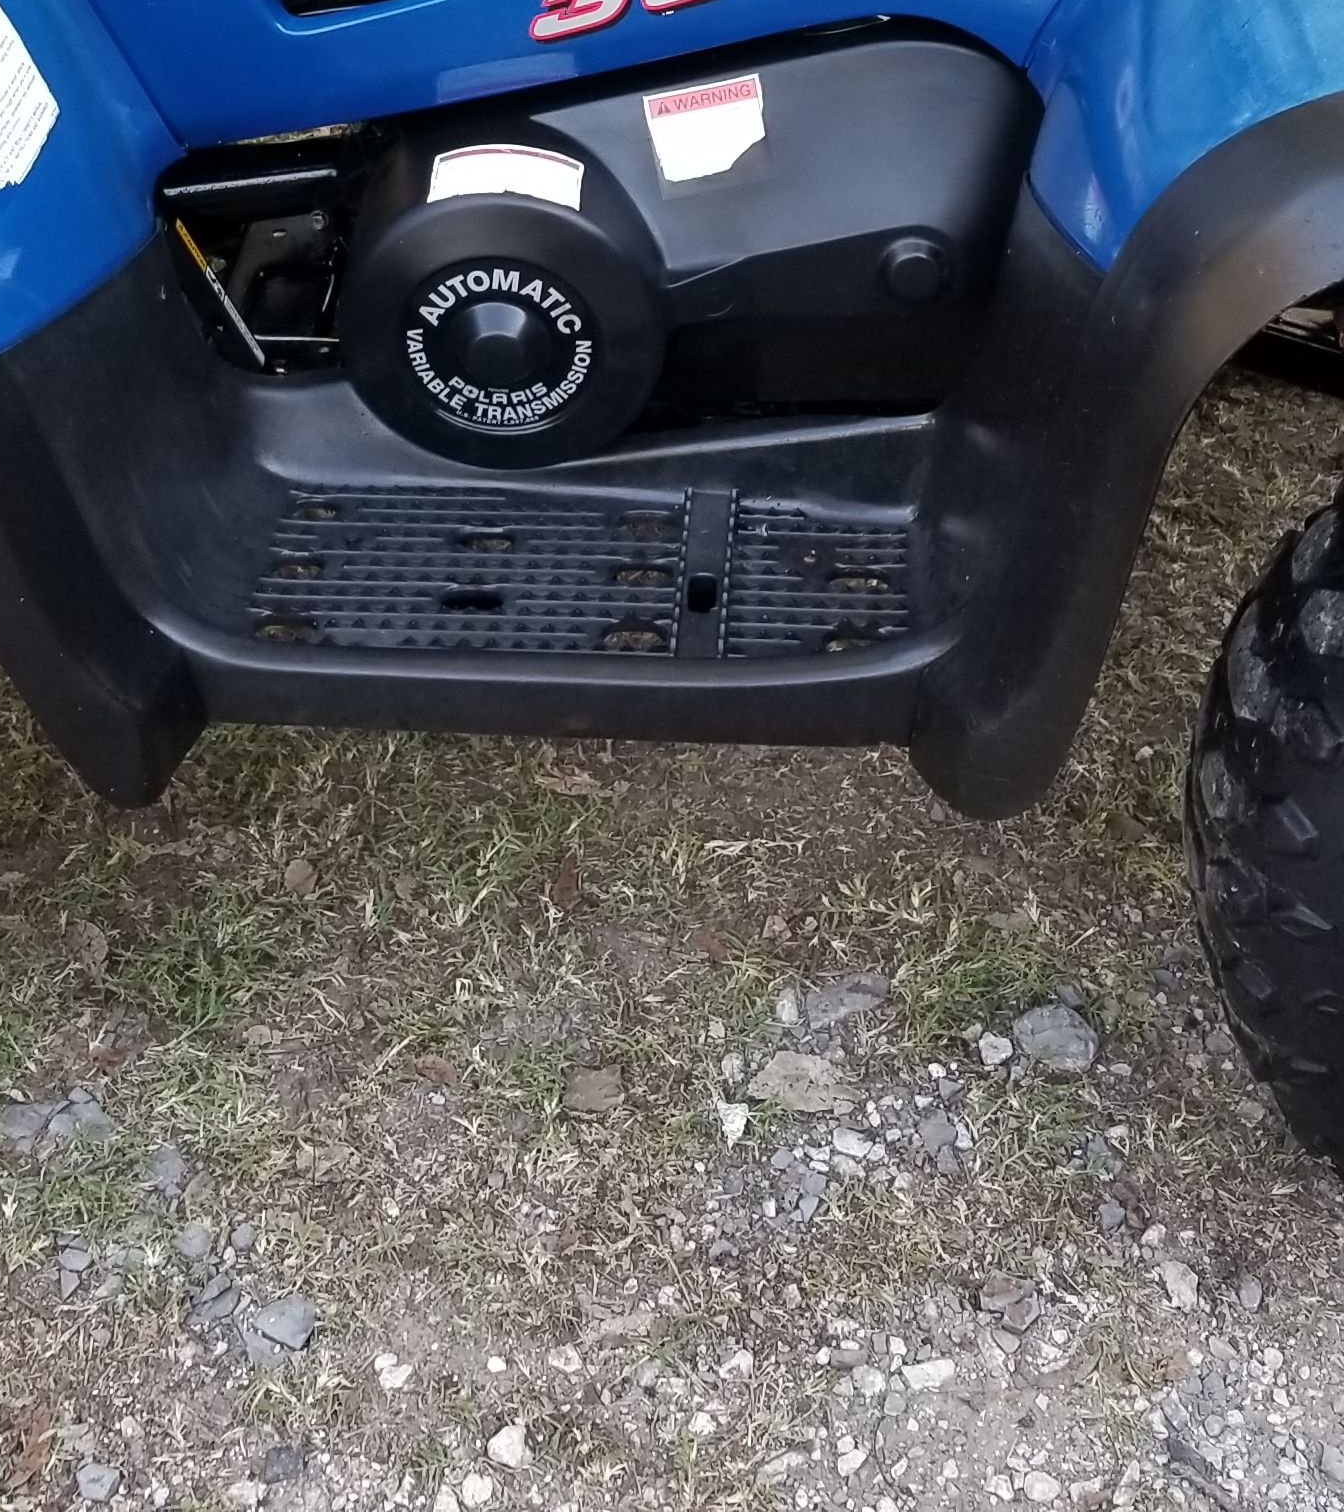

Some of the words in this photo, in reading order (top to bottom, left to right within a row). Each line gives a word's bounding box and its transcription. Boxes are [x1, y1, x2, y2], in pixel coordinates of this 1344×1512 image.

[673, 83, 752, 111] WARNING
[418, 268, 582, 335] AUTOMATIC
[406, 328, 468, 411] VARIABLE
[474, 340, 593, 420] TRANSMISSION
[447, 375, 548, 405] POLARIS
